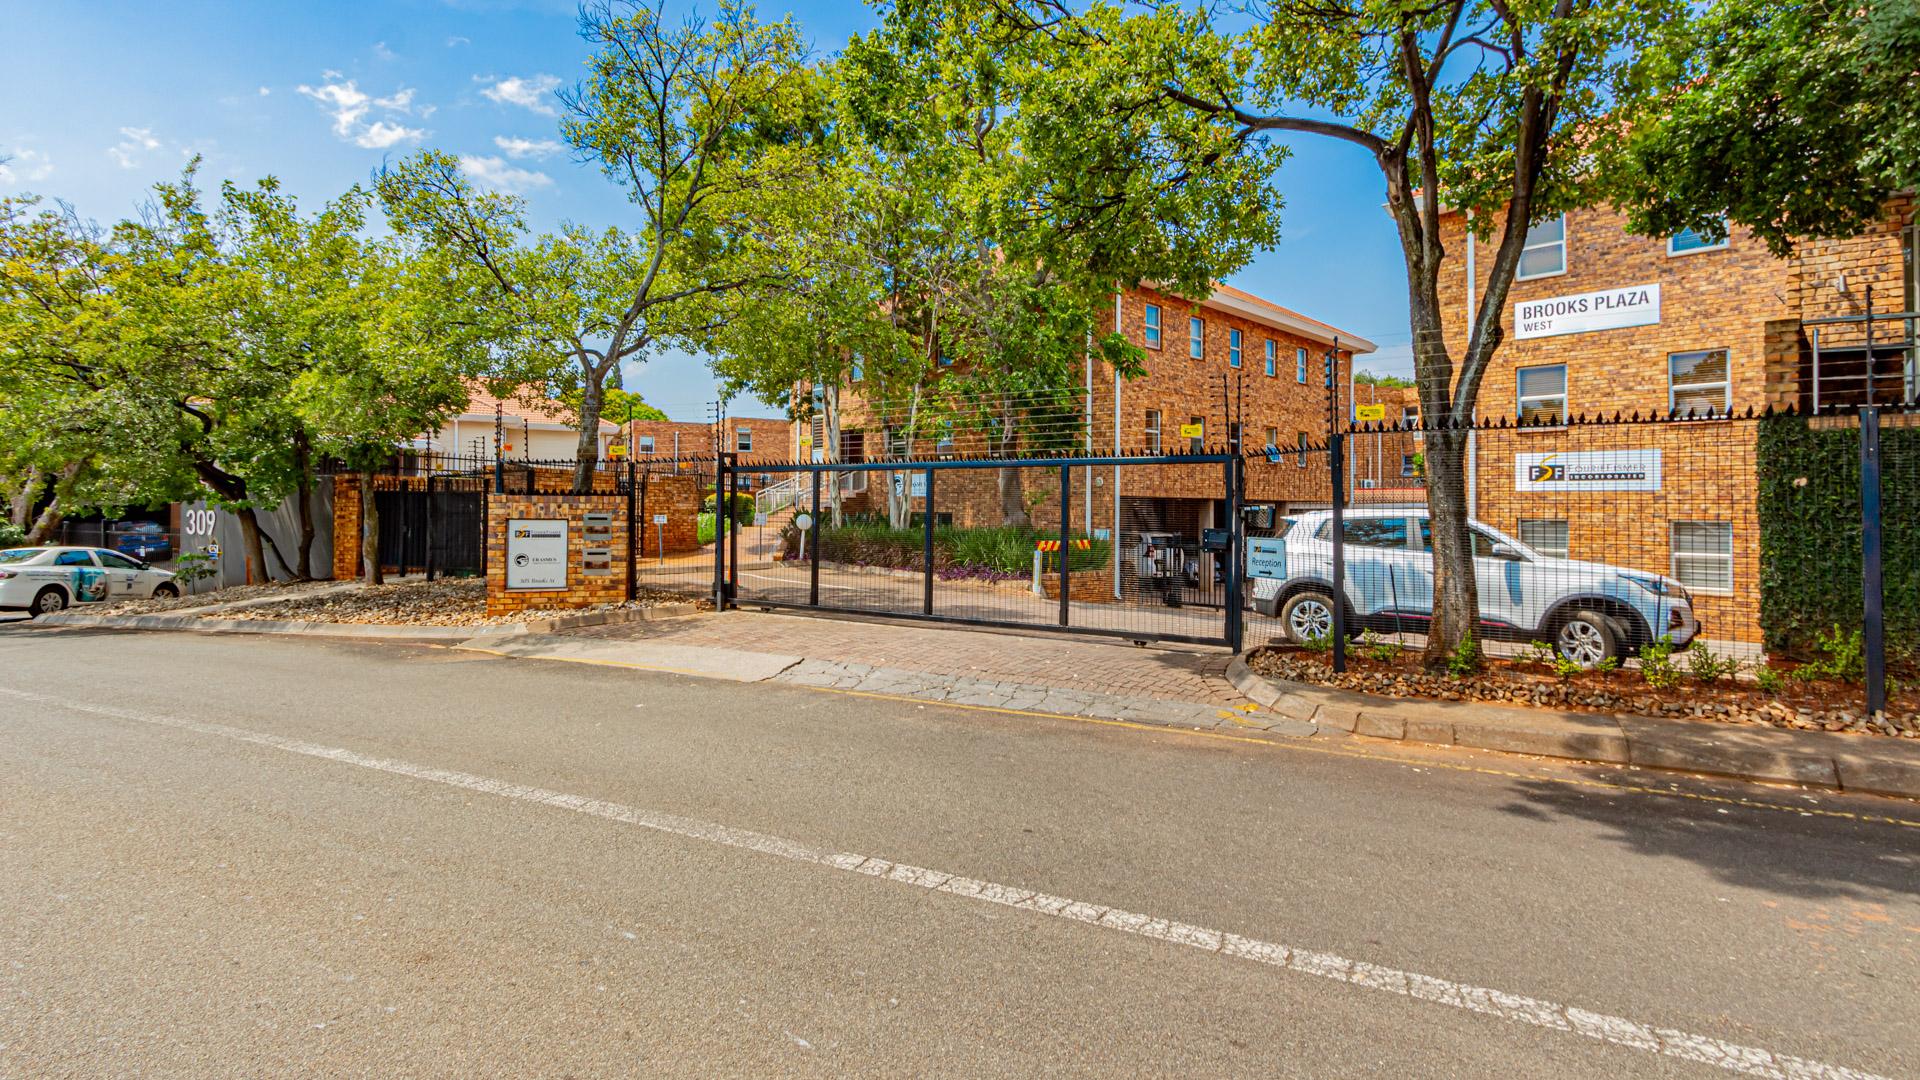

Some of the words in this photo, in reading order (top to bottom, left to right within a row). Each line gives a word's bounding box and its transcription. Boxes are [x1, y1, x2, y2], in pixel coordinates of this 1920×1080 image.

[1523, 299, 1588, 320] BROOKS
[1595, 290, 1650, 310] PLAZA
[1523, 320, 1553, 332] WEST
[186, 509, 216, 536] 309
[1251, 557, 1282, 569] Reception
